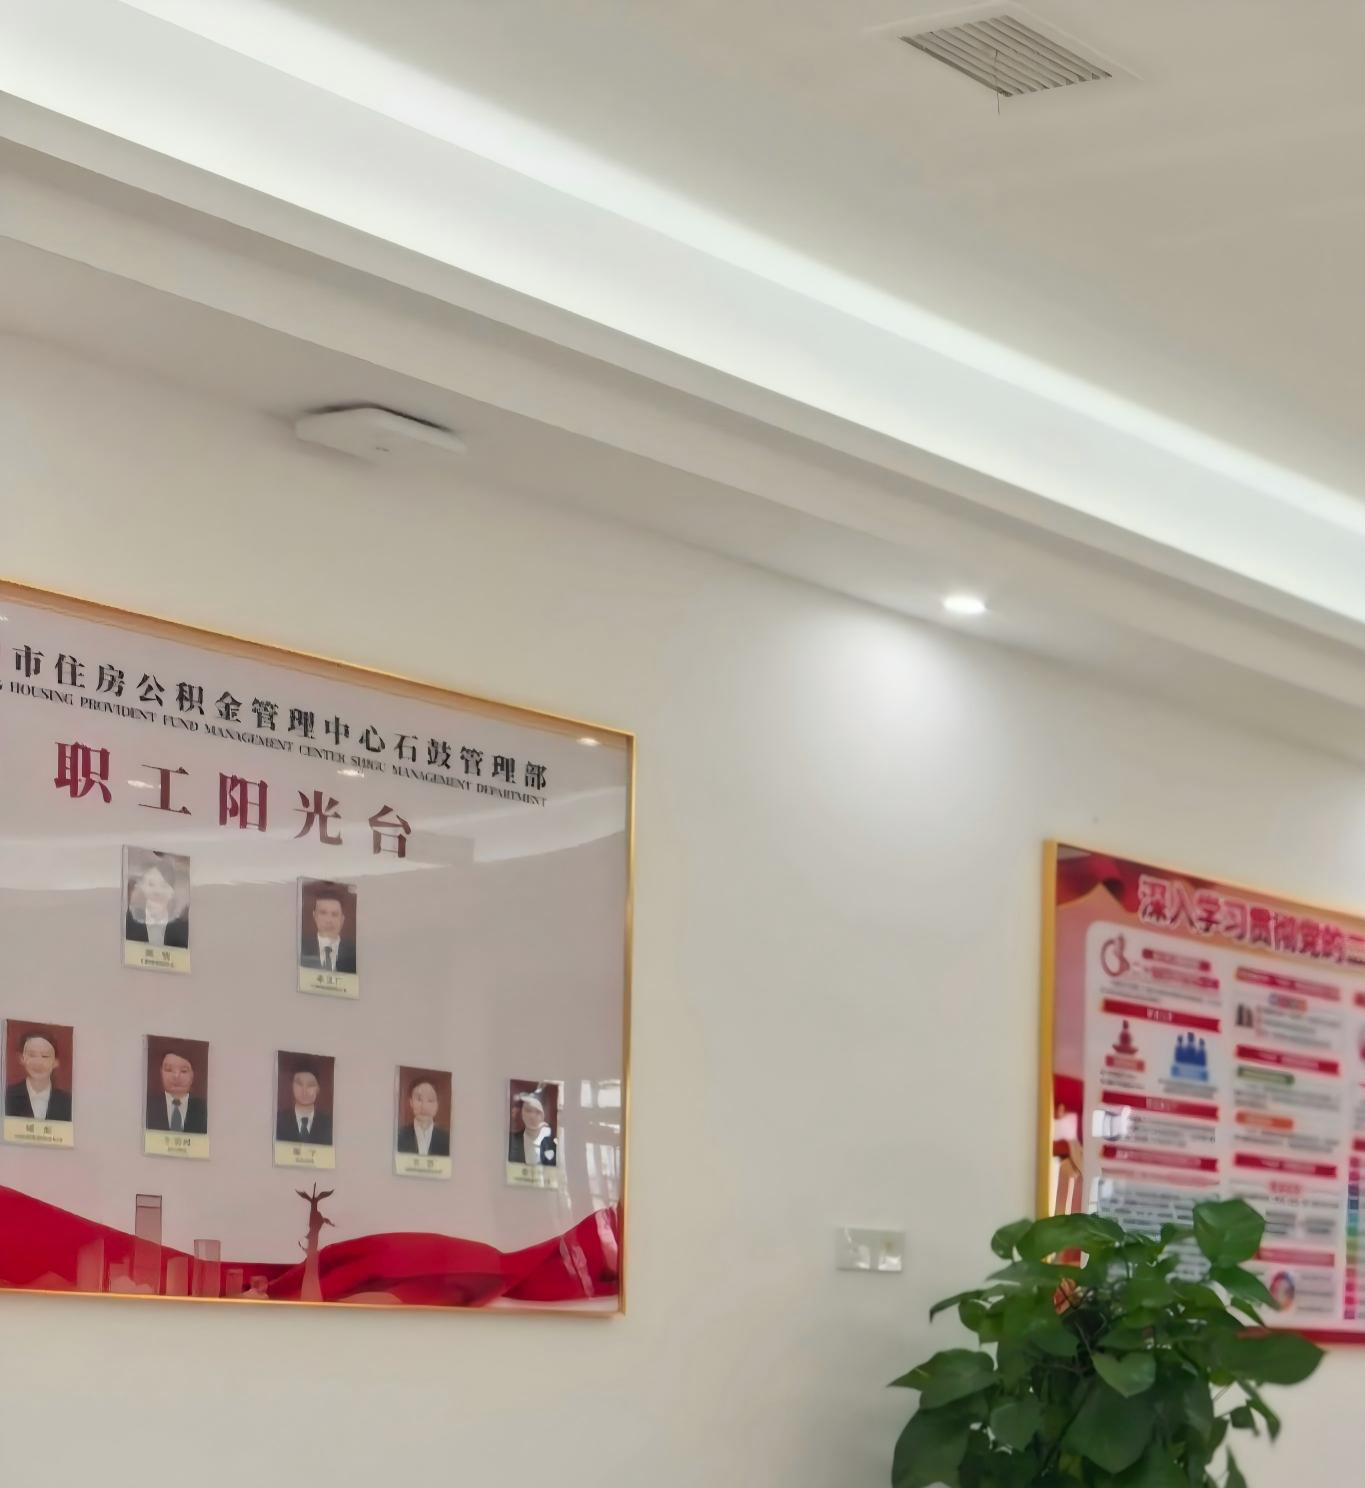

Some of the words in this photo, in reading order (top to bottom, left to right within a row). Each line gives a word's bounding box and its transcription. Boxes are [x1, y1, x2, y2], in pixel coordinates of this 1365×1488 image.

[10, 681, 74, 706] HOUSING
[12, 644, 548, 790] 市住房公积金管理中心石鼓管理部
[54, 742, 412, 858] 职工阳光台
